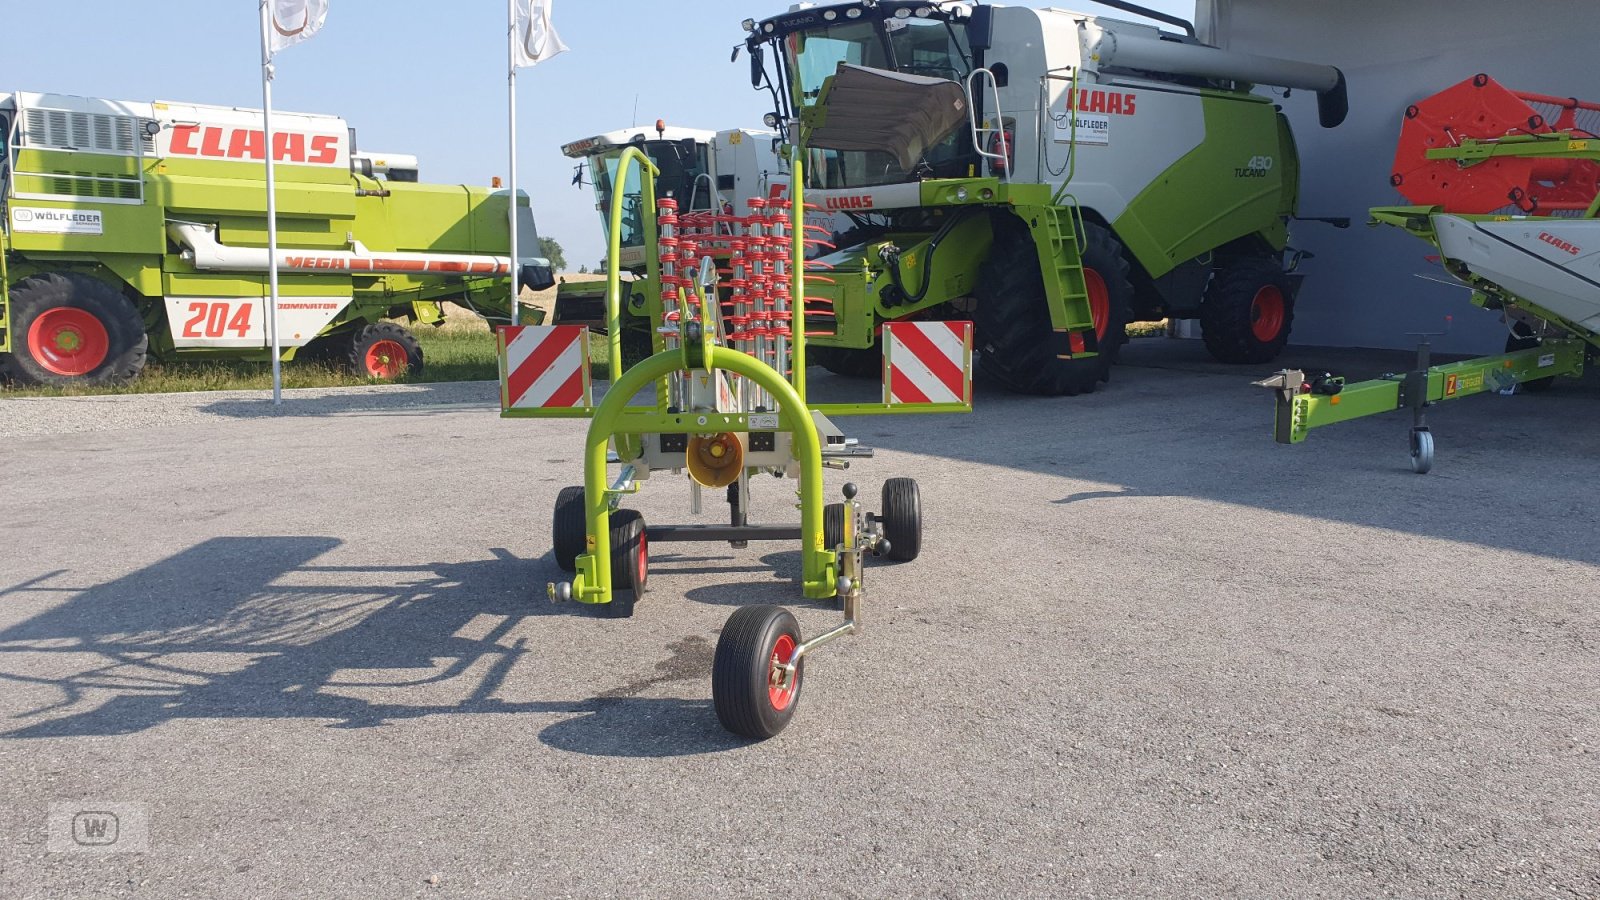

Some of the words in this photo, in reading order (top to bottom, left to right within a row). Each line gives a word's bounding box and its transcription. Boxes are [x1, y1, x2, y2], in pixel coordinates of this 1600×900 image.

[1066, 88, 1136, 115] CLAAS
[169, 124, 338, 164] CLAAS
[1247, 155, 1273, 170] 430
[1234, 168, 1266, 178] TUCANO
[826, 195, 873, 208] CLAAS
[35, 211, 100, 222] WÖLFLEDER
[1538, 231, 1581, 256] CLAAS
[285, 257, 344, 269] MEGA
[182, 302, 252, 338] 204
